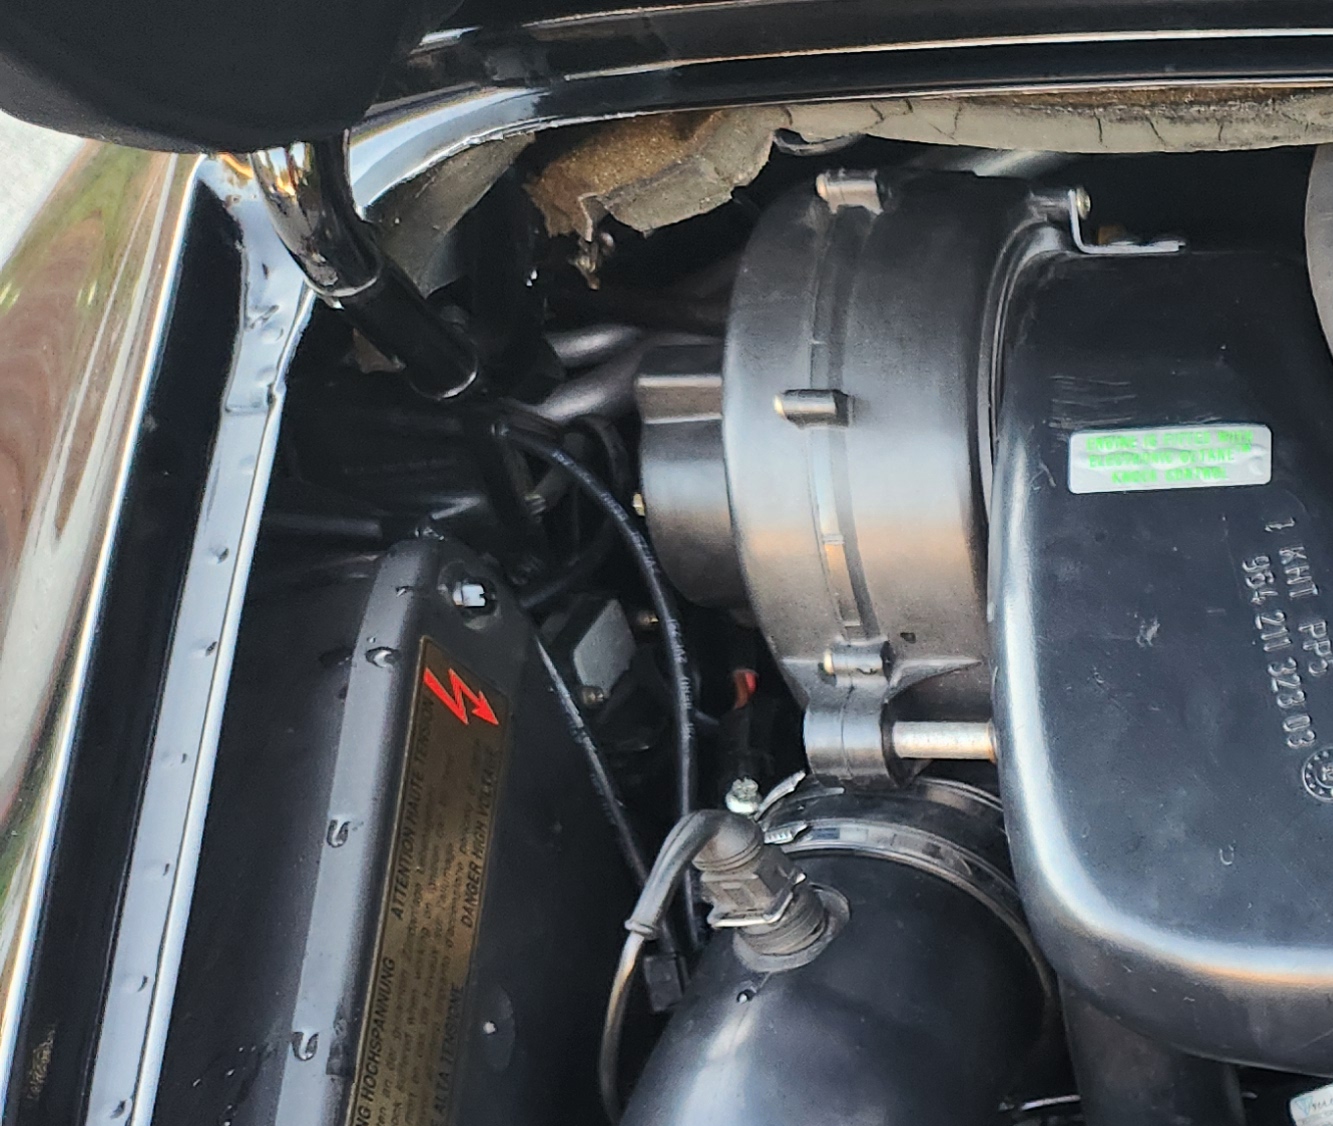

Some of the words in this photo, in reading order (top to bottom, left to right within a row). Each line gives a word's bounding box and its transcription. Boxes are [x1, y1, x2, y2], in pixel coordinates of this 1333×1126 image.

[1242, 555, 1279, 605] 964
[1255, 610, 1292, 652] 211
[1267, 656, 1306, 709] 323
[1282, 713, 1317, 749] 03
[471, 820, 488, 860] HIGH
[460, 861, 483, 929] DANGER
[361, 956, 396, 1105] HOCHSPANNUNG
